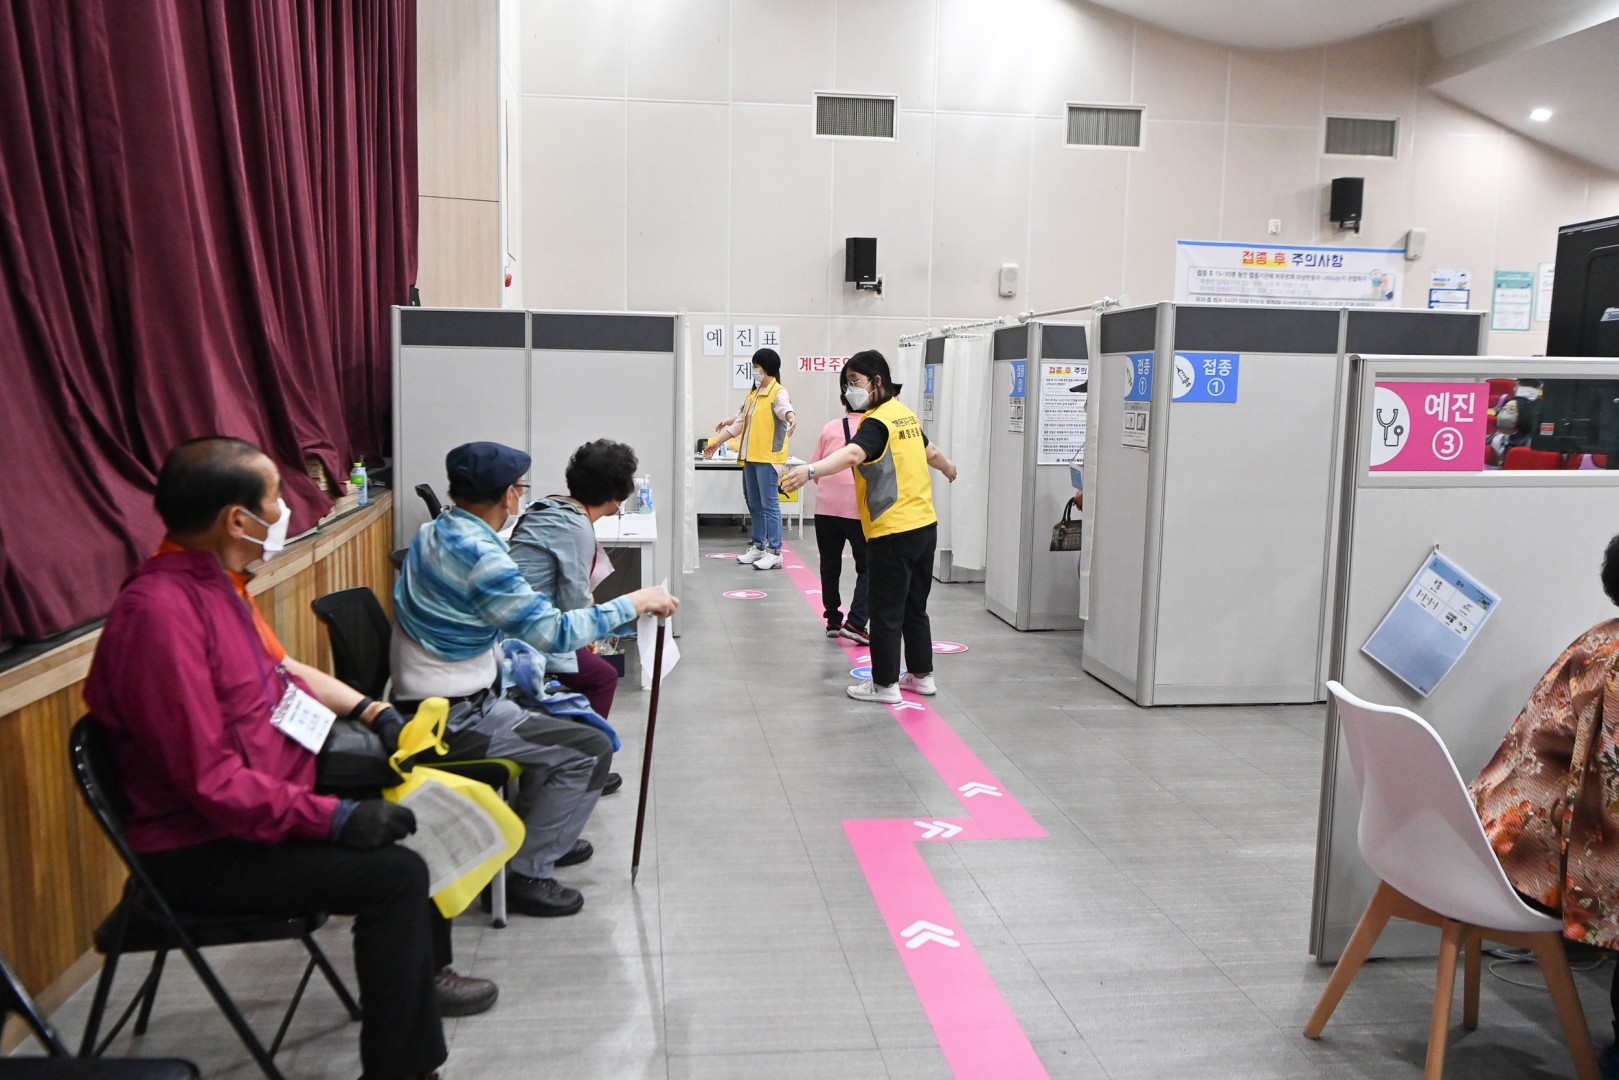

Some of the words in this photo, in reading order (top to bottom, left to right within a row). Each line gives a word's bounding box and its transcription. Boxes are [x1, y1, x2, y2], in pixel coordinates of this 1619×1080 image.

[1242, 251, 1269, 265] 접종
[1273, 252, 1286, 265] 후
[1291, 253, 1344, 267] 주의사항
[1049, 366, 1063, 374] 접종
[1138, 358, 1151, 375] 접종
[1202, 358, 1233, 376] 접종
[1424, 391, 1475, 422] 예진
